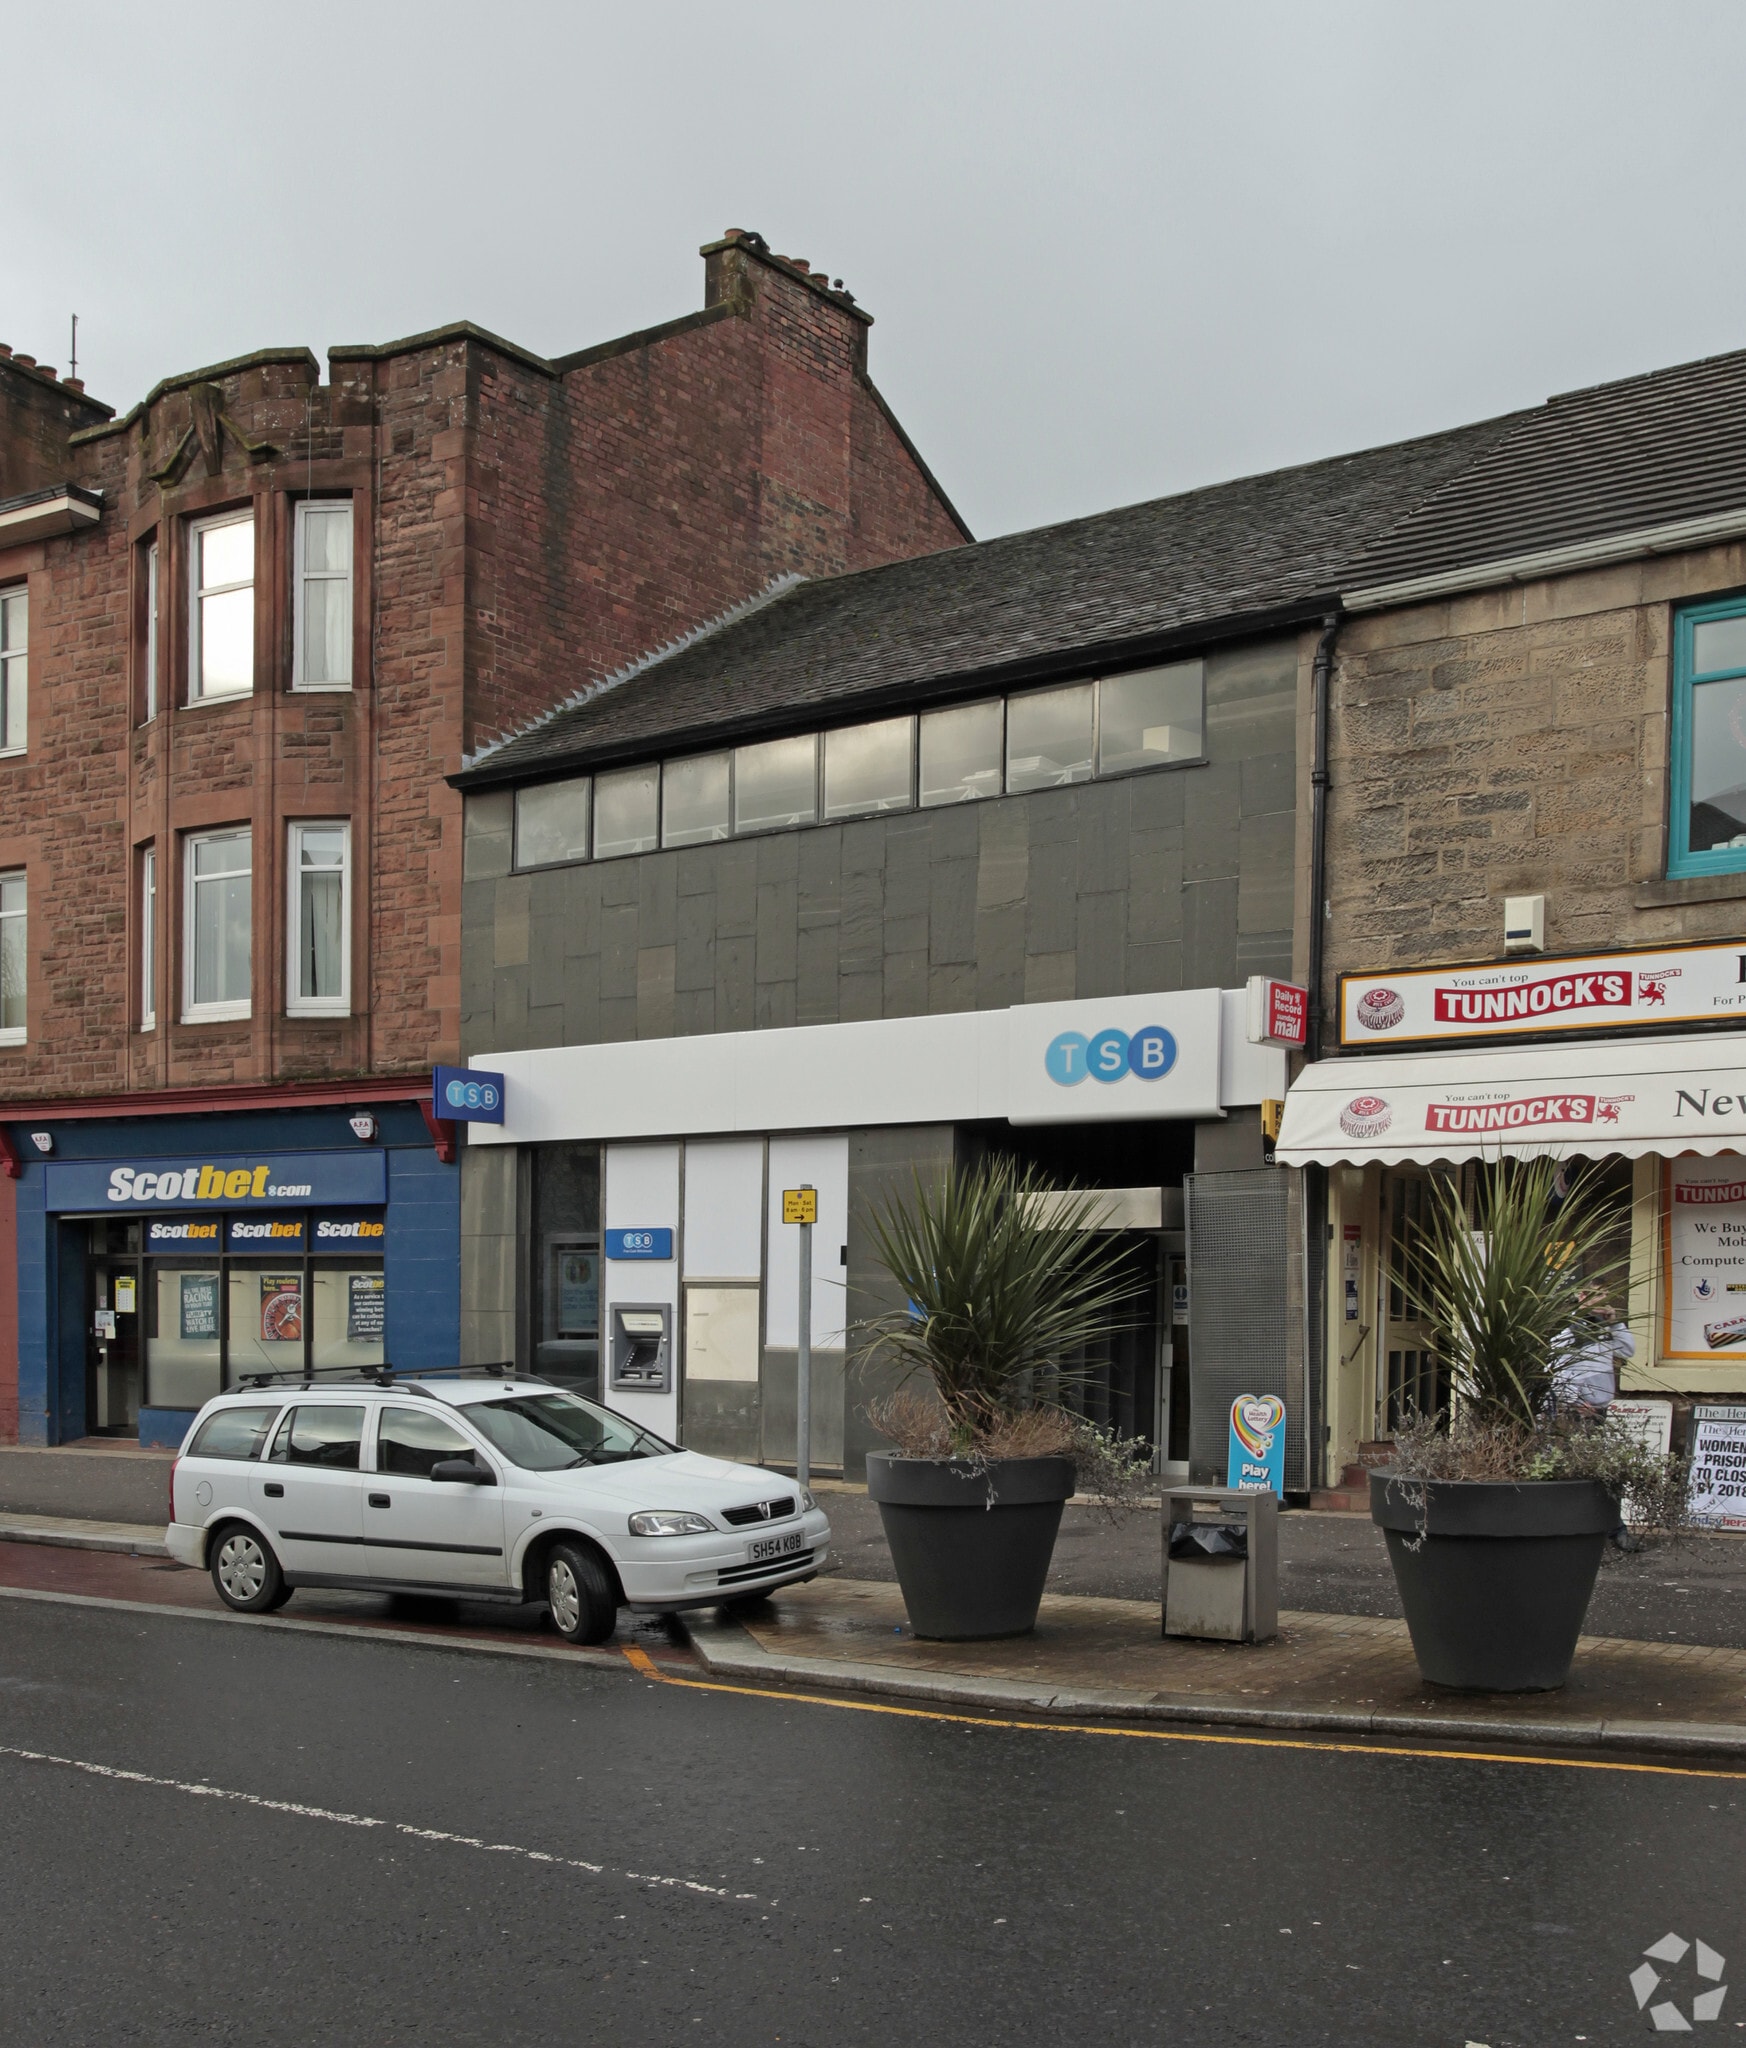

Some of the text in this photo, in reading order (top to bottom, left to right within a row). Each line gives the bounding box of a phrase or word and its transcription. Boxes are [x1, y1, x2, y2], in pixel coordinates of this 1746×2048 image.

[1452, 975, 1529, 987] You can't top
[1640, 970, 1680, 980] TUNNOCK'S
[1275, 988, 1294, 1004] Daily
[1442, 974, 1624, 1020] TUNNOCK'S
[1713, 996, 1733, 1006] For
[1275, 1000, 1302, 1015] Record
[1277, 1014, 1296, 1024] sunday
[1274, 1018, 1301, 1039] mail
[1467, 1093, 1491, 1101] can't
[1493, 1093, 1510, 1101] top
[1434, 1098, 1588, 1130] TUNNOCK'S
[1680, 1185, 1746, 1202] TUNNO
[150, 1223, 218, 1239] Scotbet
[231, 1222, 303, 1238] Scotbet
[317, 1220, 384, 1237] Scotbe
[1695, 1223, 1717, 1233] We
[263, 1277, 298, 1285] Play roulette
[184, 1292, 213, 1304] RACING
[186, 1316, 214, 1326] WATCH IT
[187, 1324, 216, 1333] LIVE HERE
[1697, 1407, 1719, 1418] The
[1703, 1425, 1721, 1435] The
[1242, 1463, 1269, 1479] Play
[1697, 1467, 1746, 1483] TO CLOS
[1238, 1479, 1271, 1490] here!
[1697, 1482, 1746, 1498] BY 2018
[753, 1540, 781, 1559] SH54
